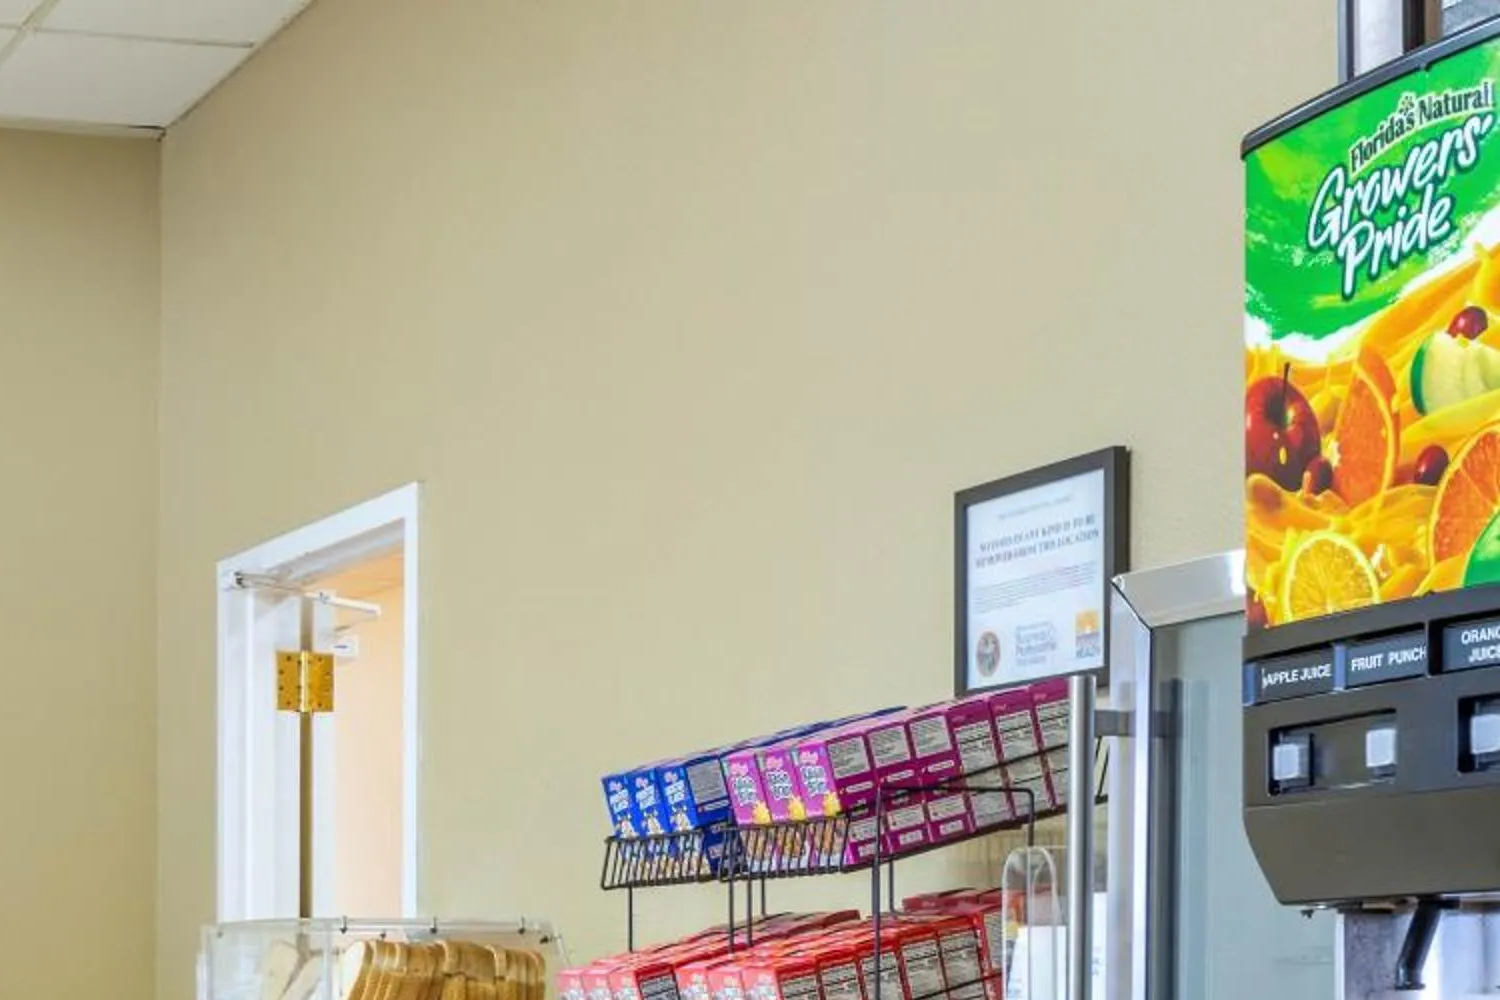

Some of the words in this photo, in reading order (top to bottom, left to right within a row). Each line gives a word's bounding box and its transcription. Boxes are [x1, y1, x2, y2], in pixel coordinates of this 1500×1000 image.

[1351, 108, 1415, 172] Florida's
[1418, 81, 1490, 124] Natural
[1337, 183, 1452, 300] Pride
[1267, 669, 1299, 685] APPLE
[1300, 663, 1332, 681] JUICE
[1351, 653, 1383, 672] FRUIT
[1387, 645, 1427, 666] PUNCH
